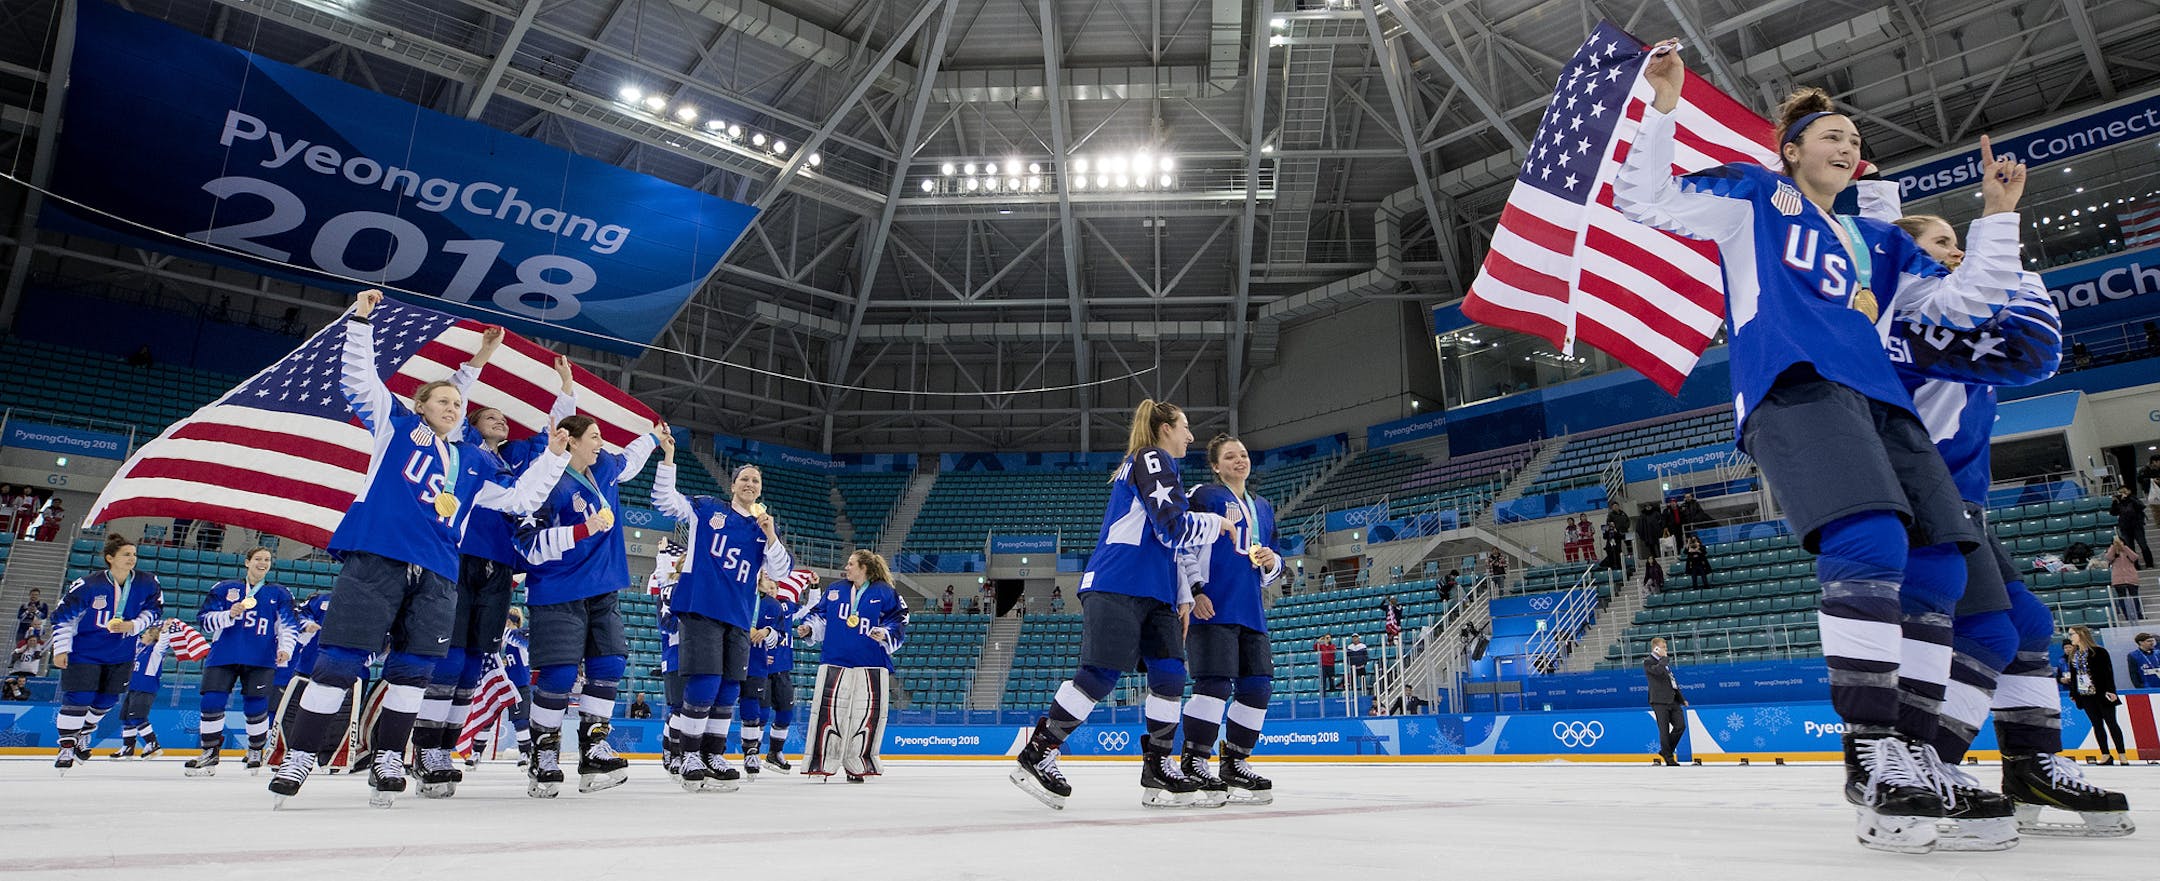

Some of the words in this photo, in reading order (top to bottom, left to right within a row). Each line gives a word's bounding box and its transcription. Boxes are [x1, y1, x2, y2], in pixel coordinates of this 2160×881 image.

[218, 109, 631, 254] PyeongChang
[186, 176, 597, 321] 2018
[1383, 421, 1433, 438] PyeongChang
[15, 430, 91, 449] PyeongChang
[92, 439, 118, 450] 2018
[781, 453, 829, 469] PyeongChang
[828, 460, 846, 469] 2018
[1143, 450, 1162, 475] 6
[47, 474, 68, 486] G5
[630, 543, 642, 553] G6
[997, 541, 1039, 549] PyeongChang
[1350, 545, 1361, 553] G8
[710, 533, 751, 584] USA
[1019, 569, 1030, 577] G7
[838, 603, 870, 635] UA
[894, 736, 958, 747] PyeongChang
[958, 736, 980, 745] 2018
[1258, 732, 1317, 745] PyeongChang
[1317, 732, 1340, 742] 2018
